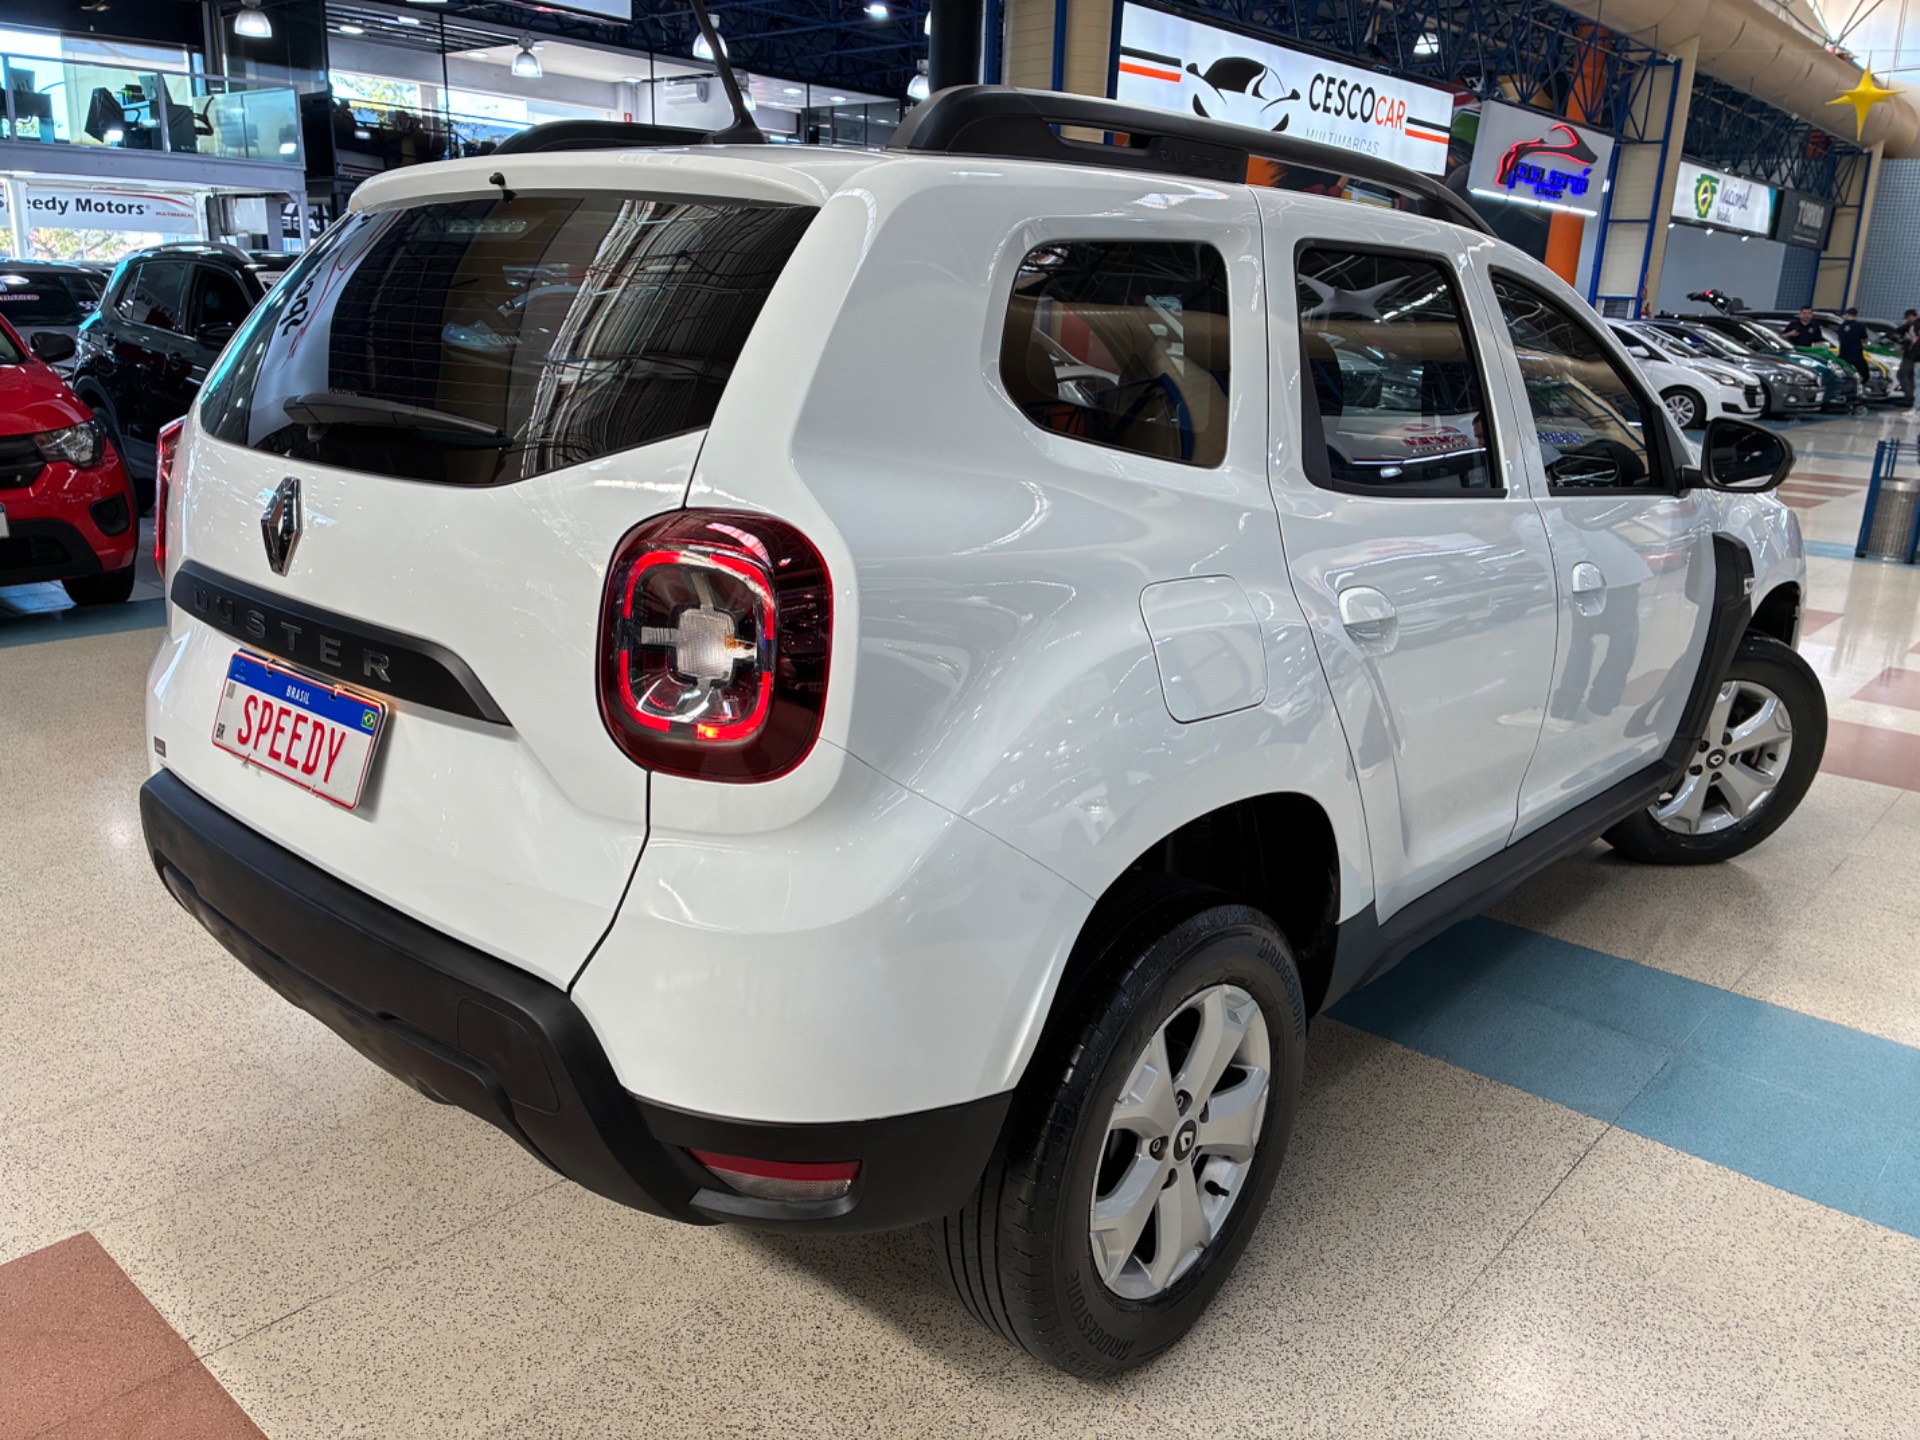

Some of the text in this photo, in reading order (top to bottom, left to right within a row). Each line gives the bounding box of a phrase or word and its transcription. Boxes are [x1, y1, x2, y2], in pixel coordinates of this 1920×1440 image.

[1309, 73, 1406, 130] CESCOCAR
[0, 193, 145, 215] edy Motors
[193, 585, 391, 683] DUSTER
[216, 722, 225, 740] BR
[286, 685, 310, 705] BRASIL
[237, 694, 346, 783] SPEEDY
[1257, 936, 1304, 1041] BRIDGESTONE
[1065, 1268, 1134, 1360] BRIDGESTONE
